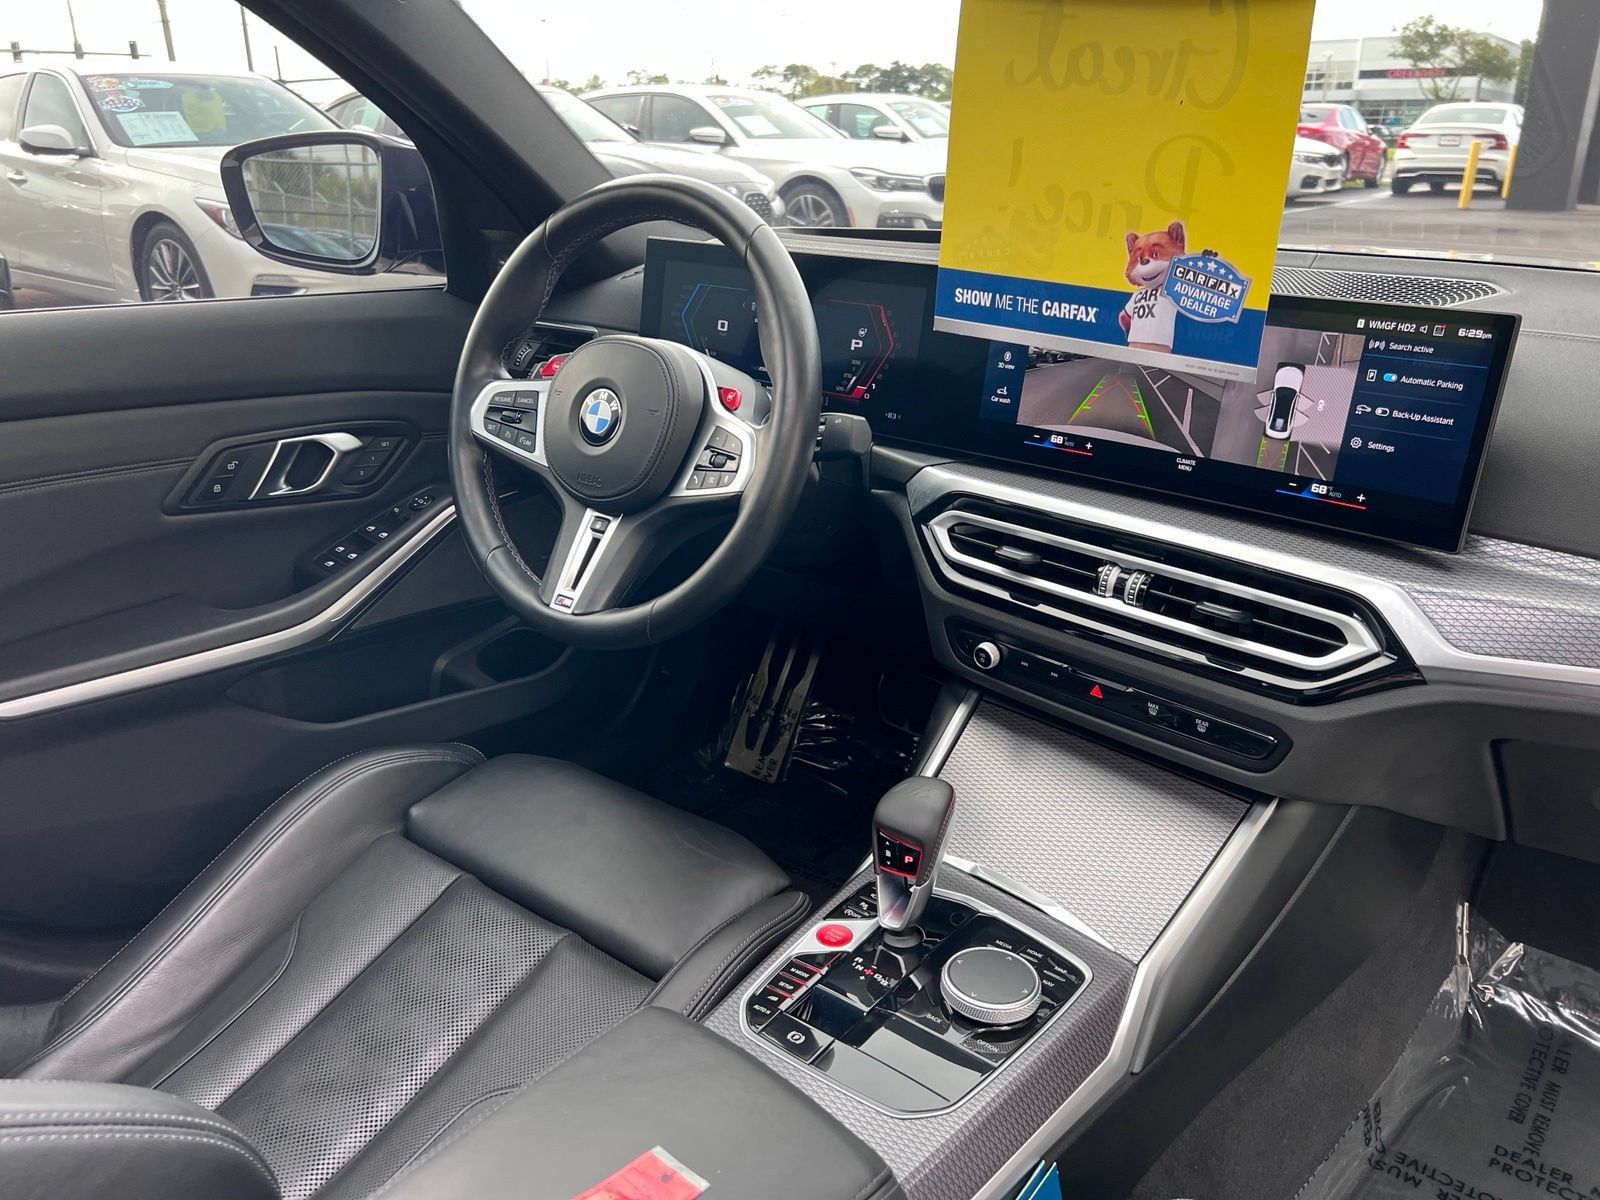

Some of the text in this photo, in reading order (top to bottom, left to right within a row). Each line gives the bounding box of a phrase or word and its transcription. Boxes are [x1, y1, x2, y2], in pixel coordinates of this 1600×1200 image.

[1175, 266, 1240, 298] CARFAX
[1134, 288, 1159, 304] CAR
[1174, 282, 1232, 310] ADVANTAGE
[954, 287, 1097, 323] SHOW ME THE CARFAX
[1133, 303, 1156, 319] FOX
[1180, 296, 1218, 318] DEALER
[1368, 320, 1416, 333] WMGF HD2
[850, 339, 863, 351] P
[1388, 342, 1434, 354] Search active
[1400, 375, 1464, 391] Automatic Parking
[1392, 410, 1454, 426] Back-Up Assistant
[1367, 441, 1395, 454] Settings
[1310, 483, 1328, 494] 68
[995, 939, 1012, 950] MEDIA
[1026, 948, 1043, 959] HOME
[926, 1013, 943, 1024] BACK
[976, 1039, 999, 1052] OPTION
[1521, 1025, 1554, 1092] OTECTIVE
[1540, 1080, 1562, 1113] MUST
[1522, 1112, 1551, 1157] REMOVE
[1493, 1144, 1574, 1186] DEALER
[1395, 1151, 1500, 1200] OTECTIVE
[1489, 1157, 1593, 1200] PROTECT
